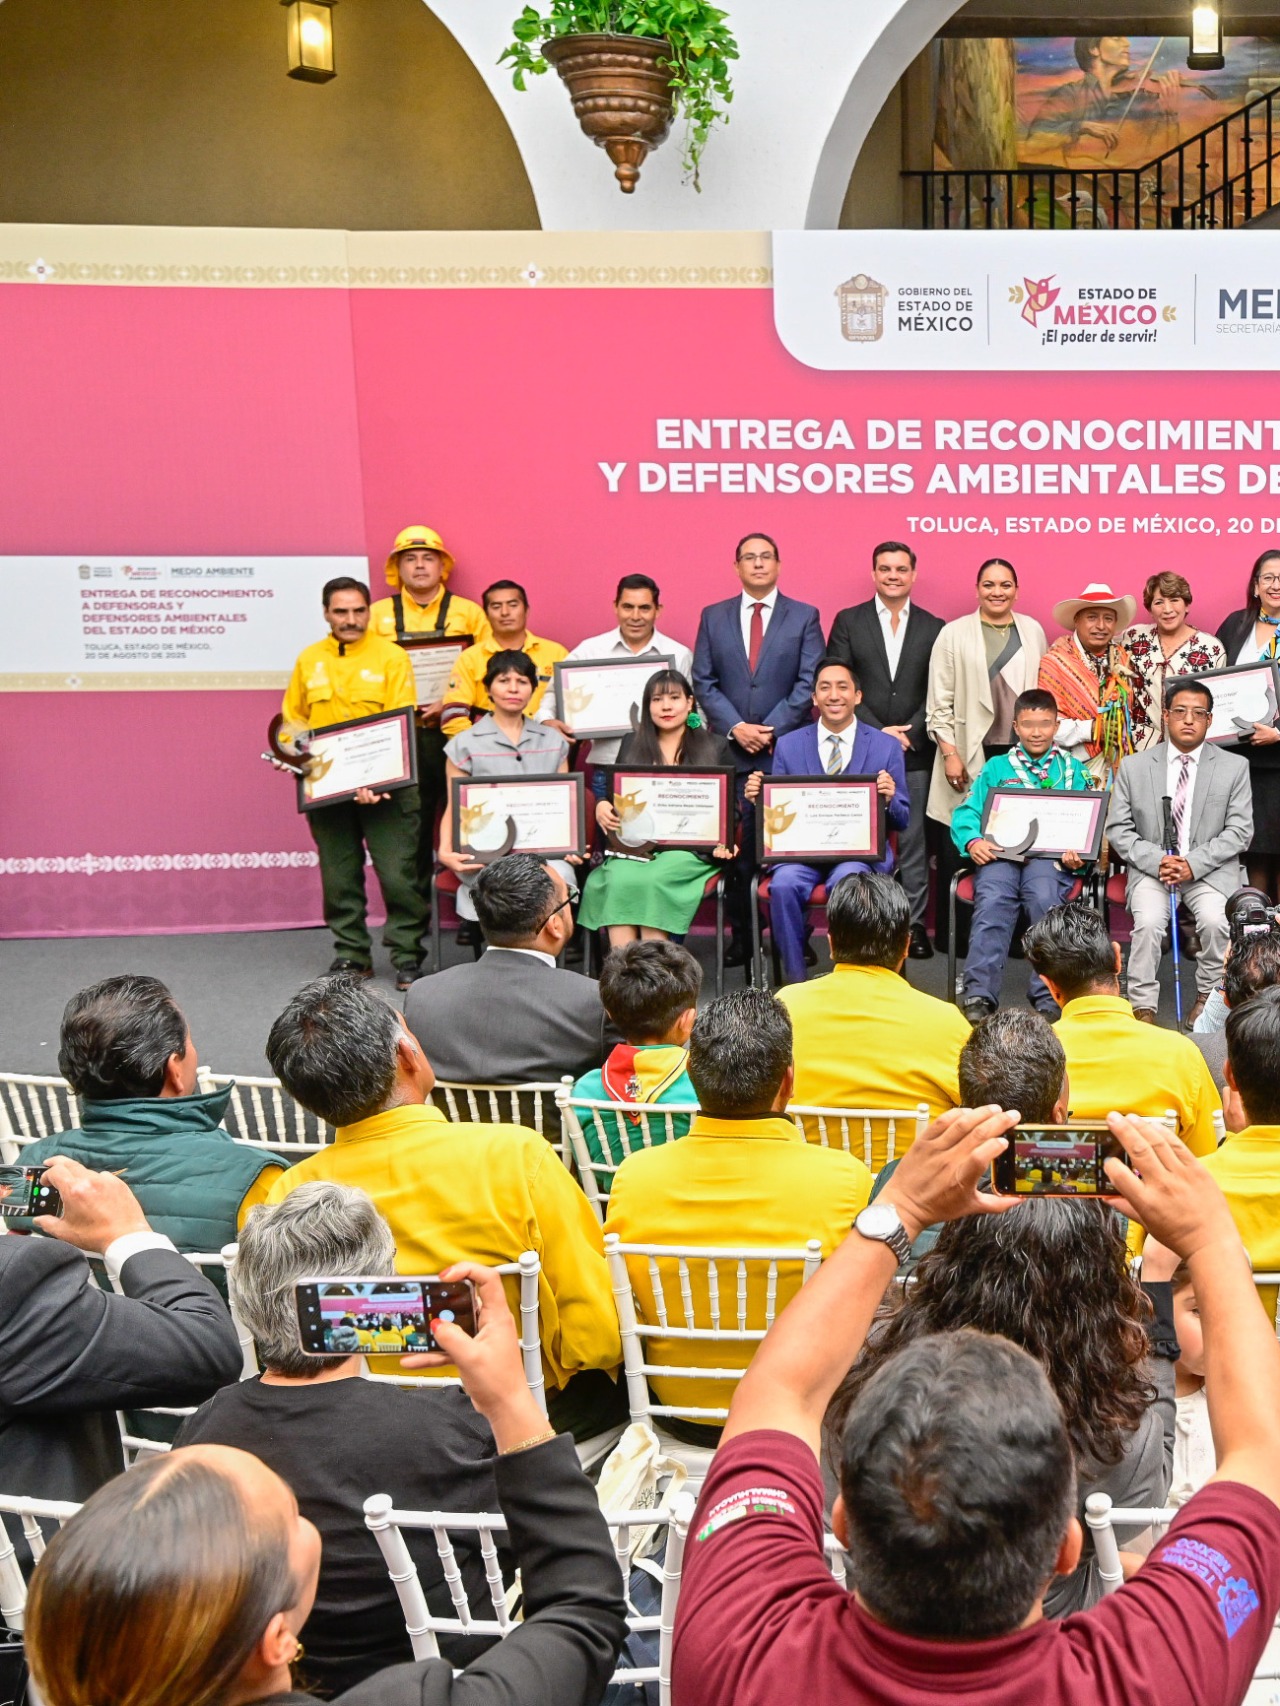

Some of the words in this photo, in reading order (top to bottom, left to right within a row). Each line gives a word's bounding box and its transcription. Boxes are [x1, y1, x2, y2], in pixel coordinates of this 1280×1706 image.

[898, 288, 951, 296] GOBIERNO
[953, 288, 972, 296] DEL
[1078, 288, 1135, 300] ESTADO
[1138, 288, 1157, 300] DE
[898, 301, 953, 311] ESTADO
[956, 301, 973, 311] DE
[1053, 303, 1157, 325] MÉXICO
[898, 314, 973, 331] MÉXICO
[1041, 330, 1058, 346] ¡El
[1061, 330, 1097, 346] poder
[1100, 330, 1115, 343] de
[1118, 329, 1157, 343] servir!
[656, 419, 856, 451] ENTREGA
[866, 420, 923, 451] DE
[597, 462, 628, 493] Y
[638, 462, 915, 495] DEFENSORES
[925, 463, 1227, 495] AMBIENTALES
[906, 517, 998, 537] TOLUCA,
[1005, 517, 1092, 534] ESTADO
[1097, 517, 1127, 534] DE
[1132, 513, 1221, 537] MÉXICO,
[1227, 517, 1255, 534] 20
[171, 567, 203, 576] MEDIO
[205, 567, 255, 576] AMBIENTE
[81, 590, 137, 599] ENTREGA
[140, 590, 156, 599] DE
[159, 589, 274, 598] RECONOCIMIENTOS
[82, 602, 91, 611] A
[93, 602, 174, 611] DEFENSORAS
[175, 602, 185, 611] Y
[82, 614, 162, 623] DEFENSORES
[164, 614, 248, 623] AMBIENTALES
[83, 626, 107, 635] DEL
[109, 626, 158, 635] ESTADO
[161, 626, 177, 635] DE
[179, 624, 226, 634] MÉXICO
[124, 643, 160, 651] ESTADO
[161, 643, 174, 651] DE
[84, 652, 96, 660] 20
[97, 652, 110, 660] DE
[112, 652, 150, 660] AGOSTO
[151, 652, 163, 660] DE
